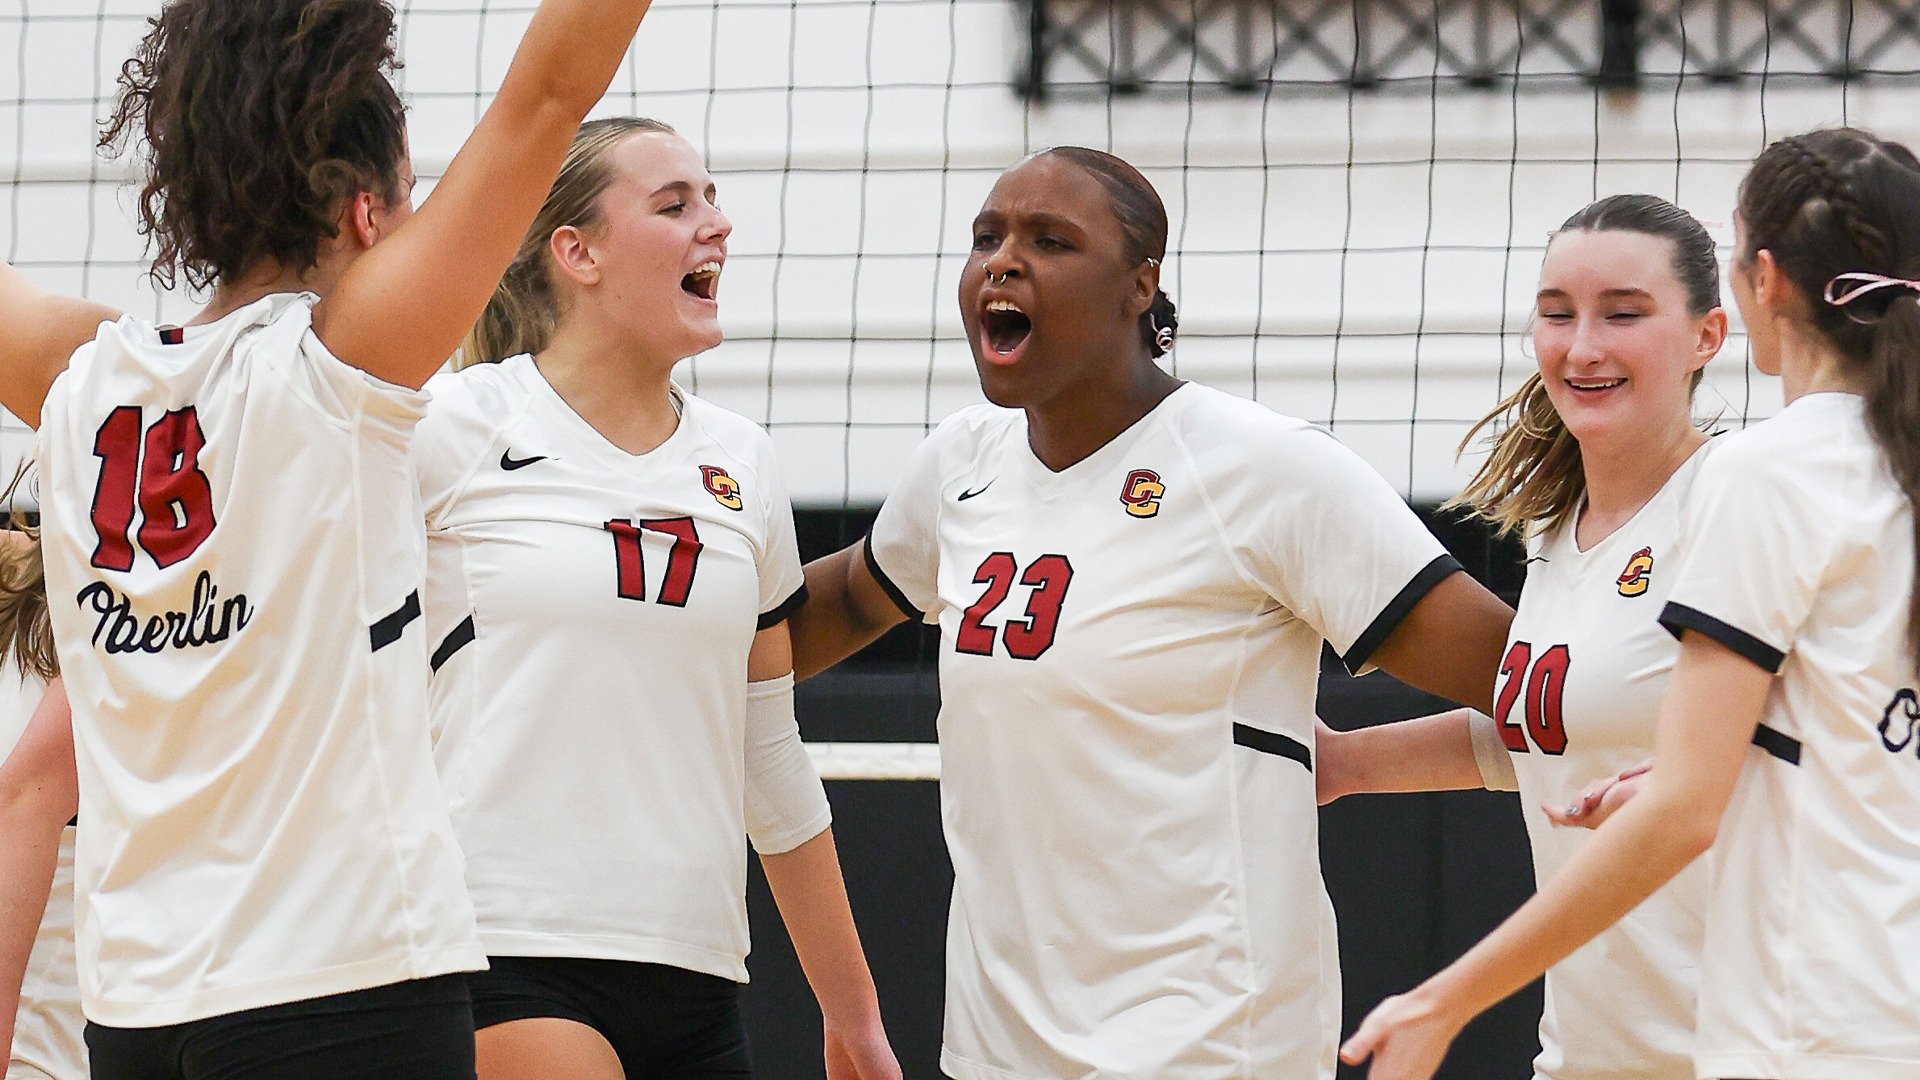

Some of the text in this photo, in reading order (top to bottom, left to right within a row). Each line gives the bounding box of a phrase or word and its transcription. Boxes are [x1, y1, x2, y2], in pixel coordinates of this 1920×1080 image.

[91, 404, 217, 573] 18
[603, 516, 704, 608] 17
[955, 552, 1074, 661] 23
[1495, 640, 1571, 756] 20
